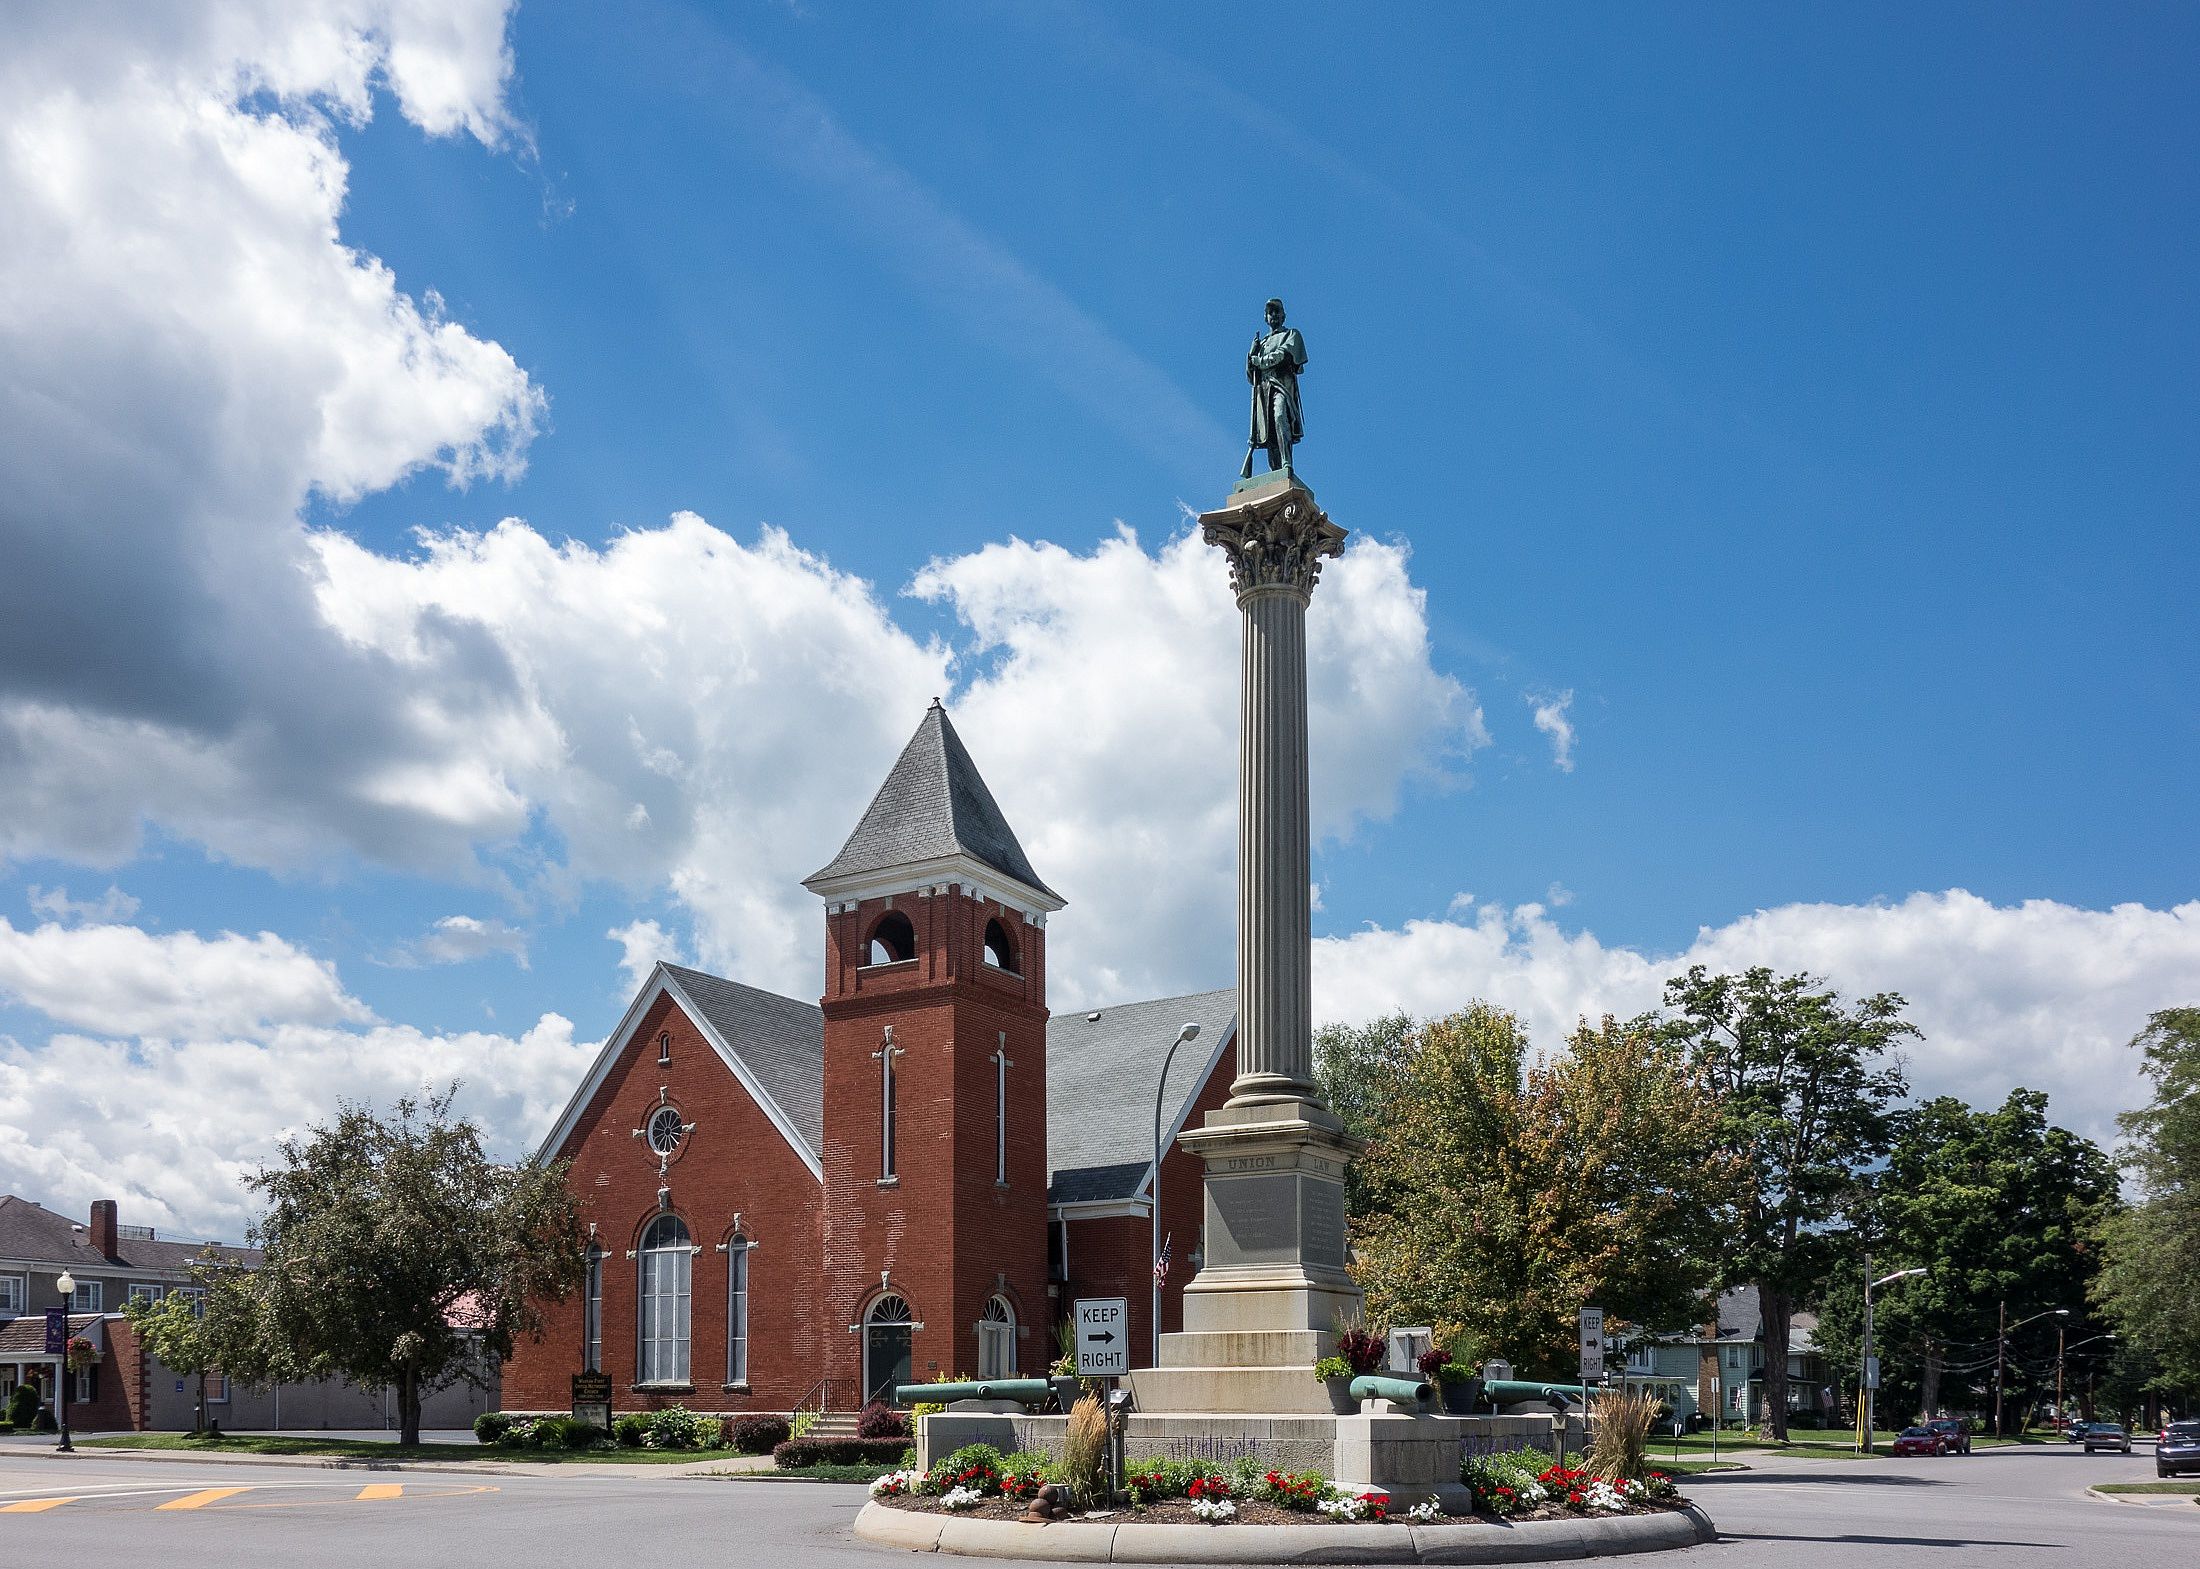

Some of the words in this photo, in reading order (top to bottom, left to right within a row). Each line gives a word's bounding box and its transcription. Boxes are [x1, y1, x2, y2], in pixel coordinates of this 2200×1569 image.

[1228, 1156, 1275, 1170] UNION
[1314, 1159, 1330, 1171] LAW
[1083, 1308, 1119, 1323] KEEP
[1584, 1316, 1600, 1330] KEEP
[1082, 1352, 1122, 1367] RIGHT
[1584, 1357, 1602, 1370] RIGHT
